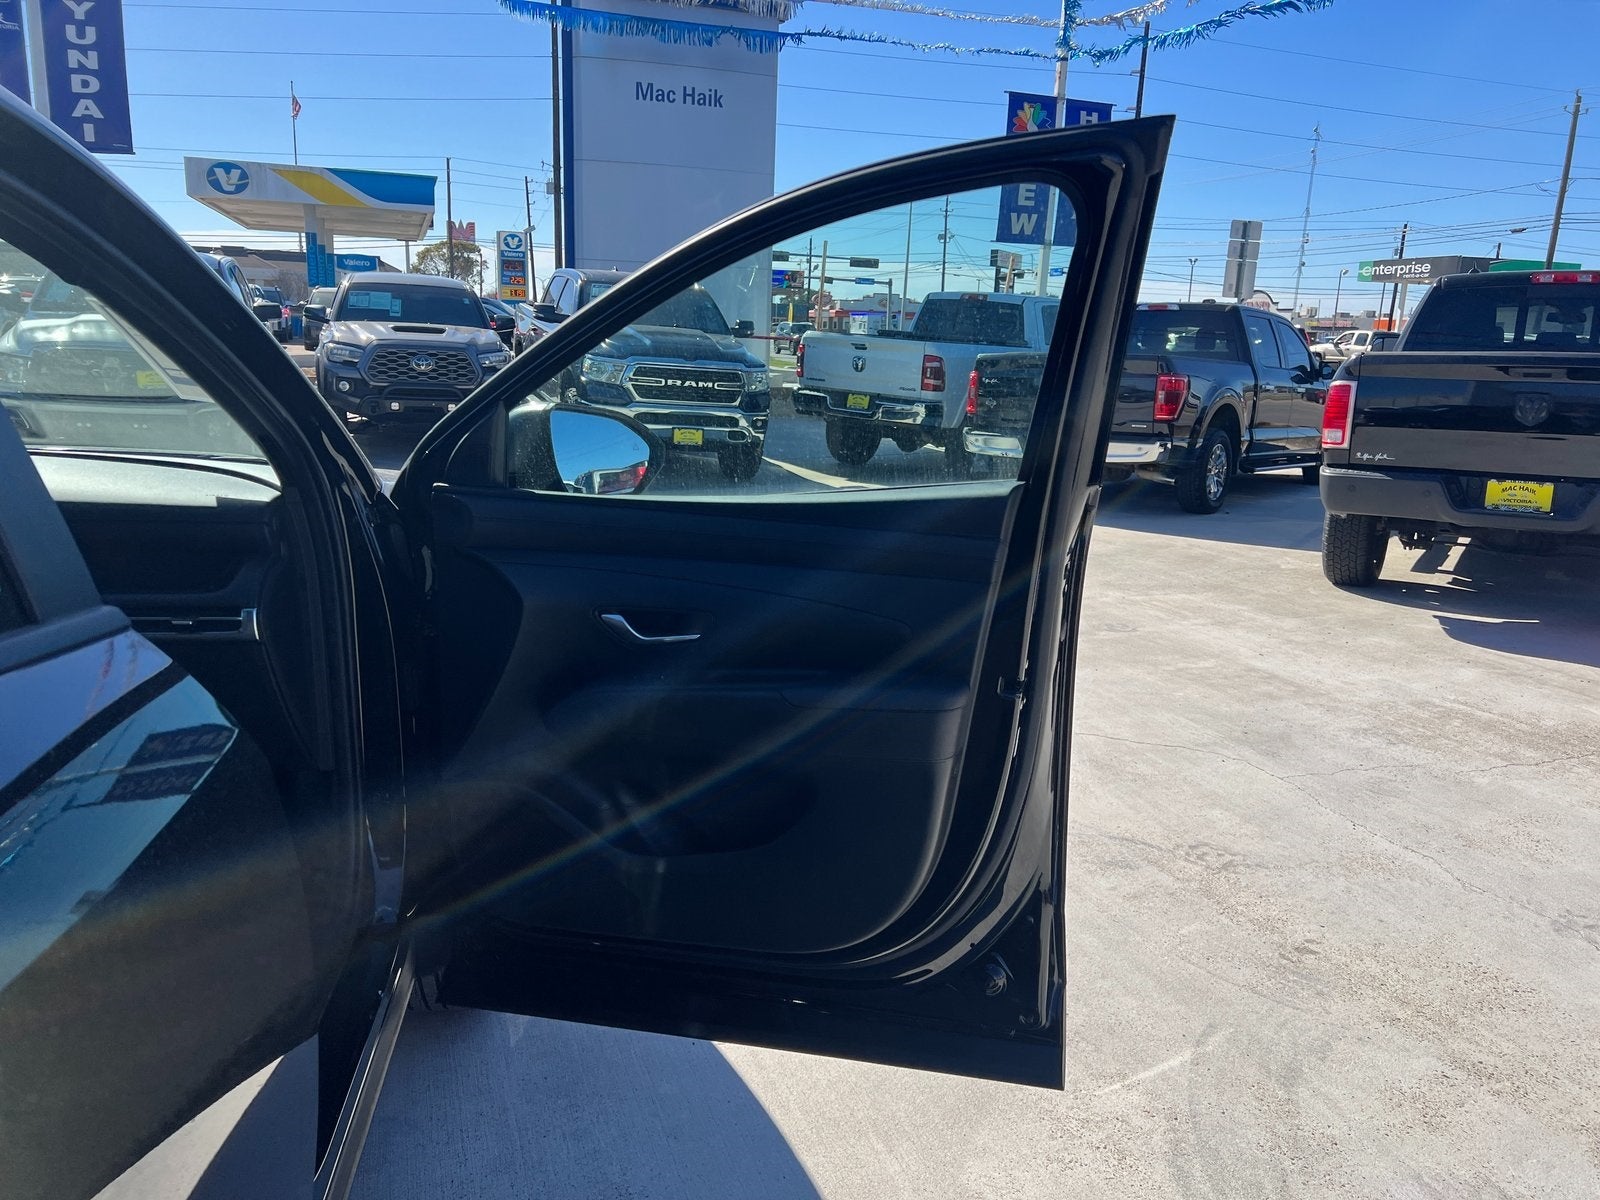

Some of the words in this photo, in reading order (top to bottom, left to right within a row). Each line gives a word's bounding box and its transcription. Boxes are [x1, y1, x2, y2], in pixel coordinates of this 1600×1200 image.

[635, 81, 676, 104] Mac
[682, 85, 724, 108] Haik
[1010, 183, 1038, 236] EW
[503, 250, 524, 258] Valero
[343, 258, 371, 267] Valero
[1359, 261, 1431, 277] enterprise
[667, 379, 713, 388] RAM
[1501, 485, 1518, 493] MAC
